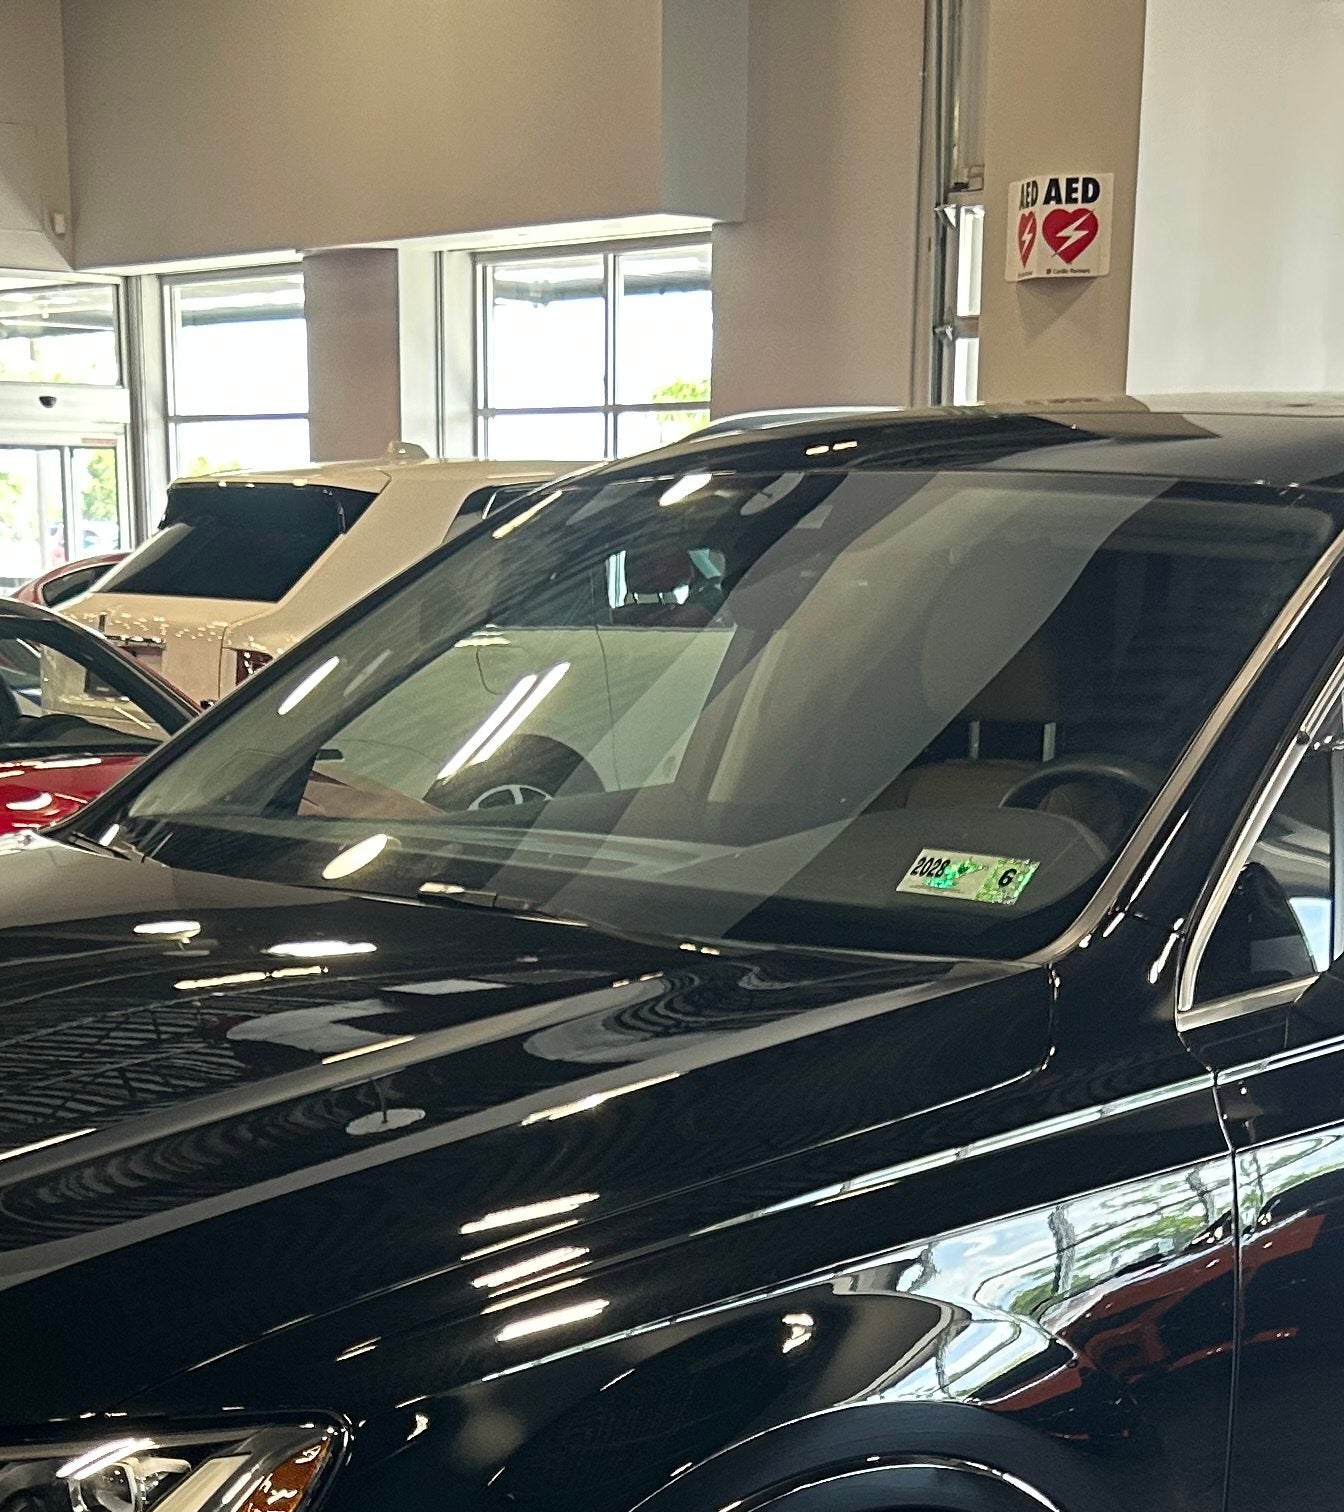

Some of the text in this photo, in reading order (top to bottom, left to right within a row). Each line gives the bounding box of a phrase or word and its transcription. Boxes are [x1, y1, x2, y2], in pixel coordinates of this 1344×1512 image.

[1019, 180, 1039, 211] AED
[1042, 177, 1101, 205] AED
[998, 868, 1017, 887] 6
